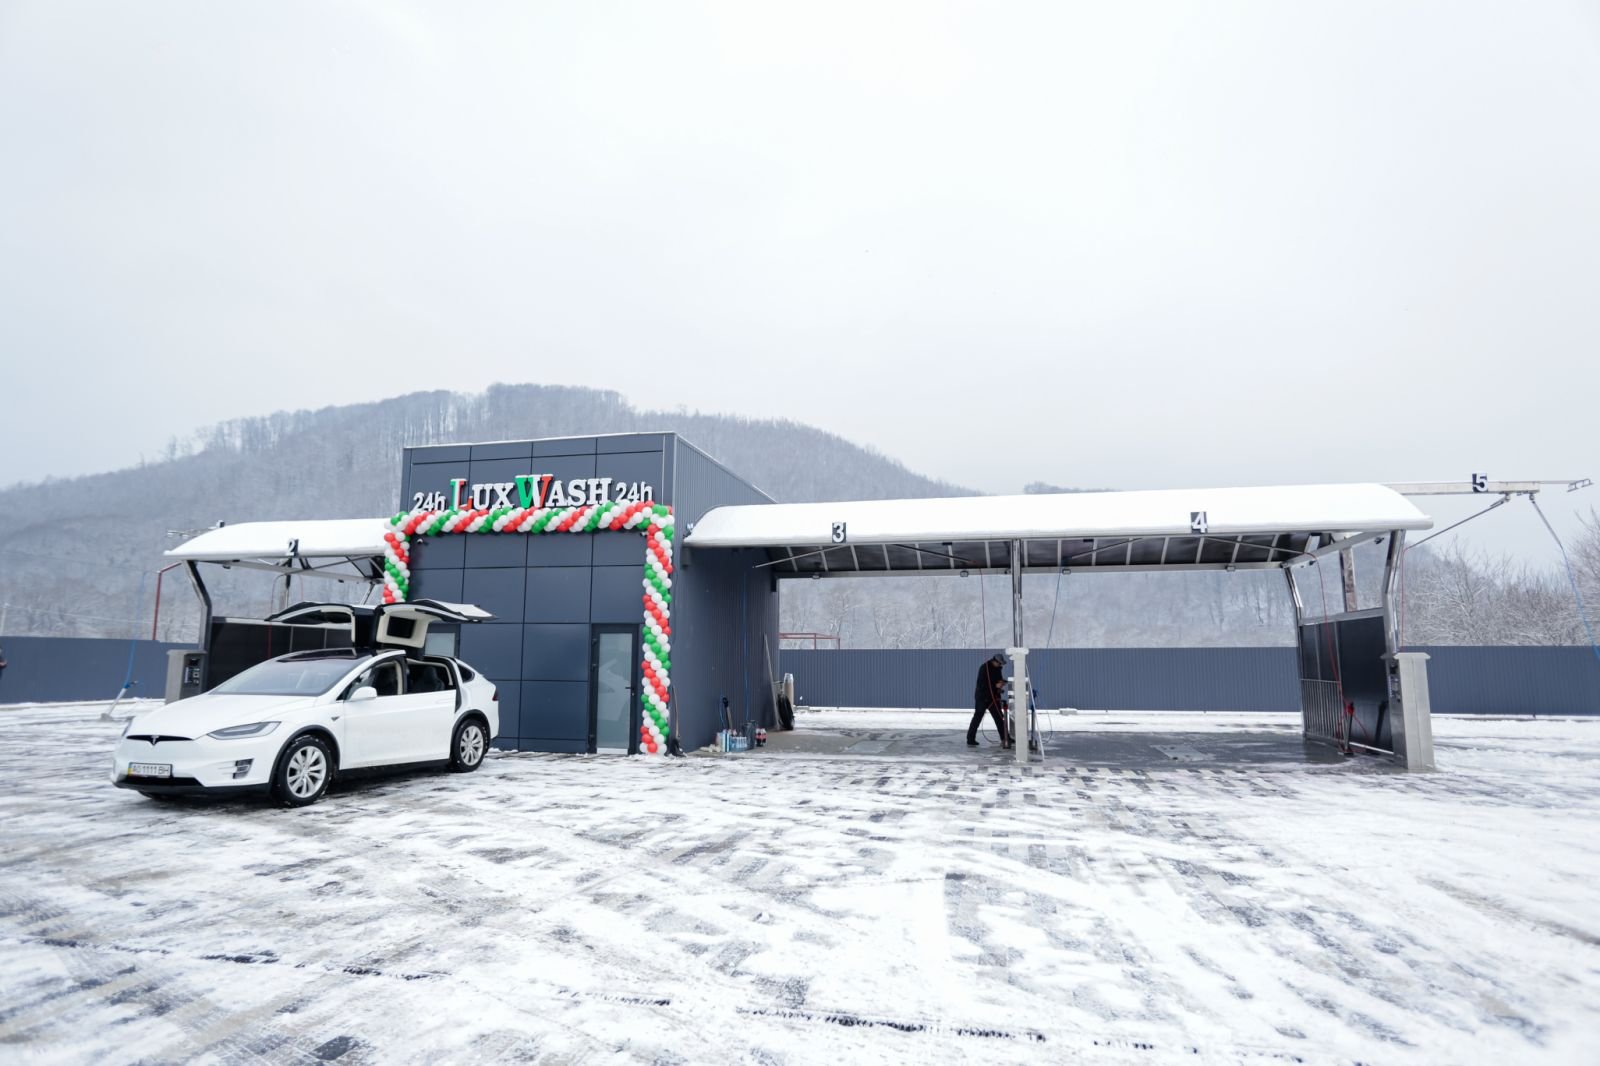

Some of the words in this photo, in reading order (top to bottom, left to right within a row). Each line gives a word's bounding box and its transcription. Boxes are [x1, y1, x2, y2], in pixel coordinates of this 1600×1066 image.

[1472, 473, 1489, 492] 5
[410, 491, 446, 512] 24h
[615, 481, 652, 503] 24h
[832, 521, 844, 543] 3
[1191, 510, 1208, 534] 4
[285, 538, 295, 556] 2
